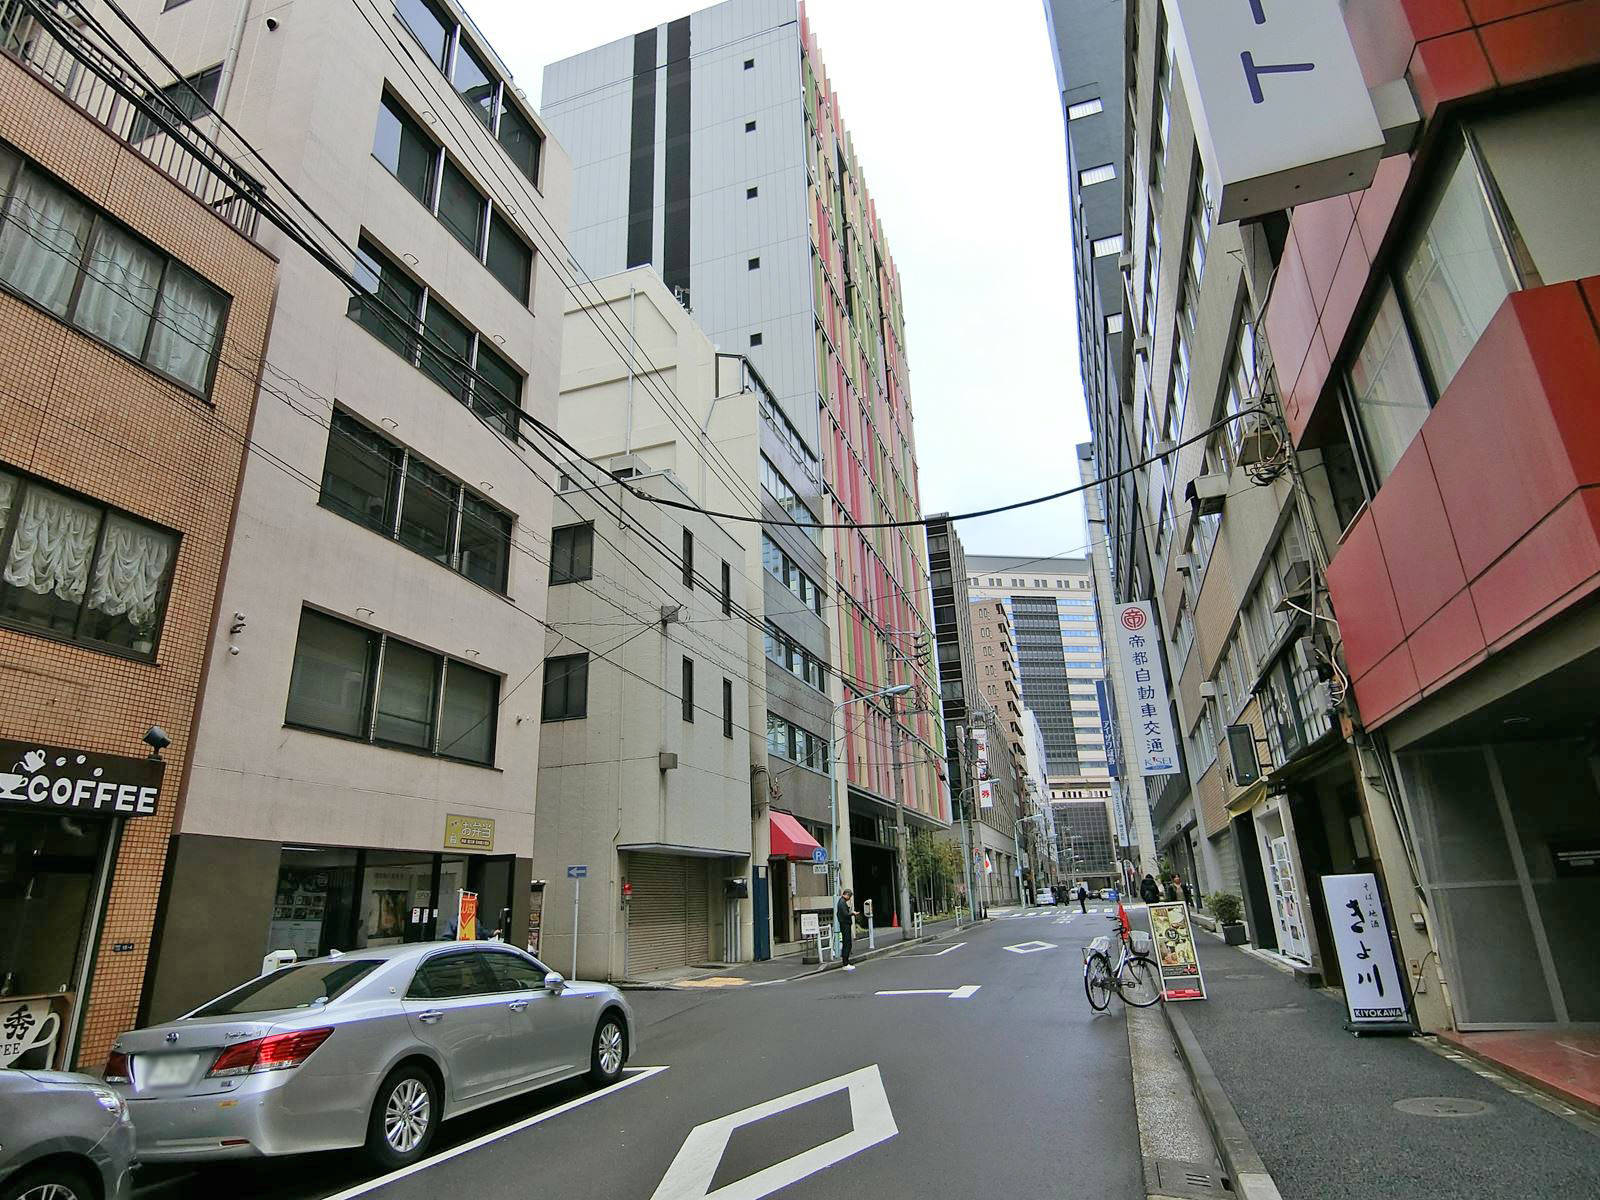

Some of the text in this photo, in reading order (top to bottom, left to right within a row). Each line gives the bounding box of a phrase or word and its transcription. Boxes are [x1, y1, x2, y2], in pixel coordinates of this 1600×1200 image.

[1129, 634, 1164, 754] 帝都自動車交通
[28, 774, 158, 814] COFFEE
[461, 821, 492, 838] お弁当
[3, 1003, 36, 1041] 秀
[1355, 1008, 1403, 1018] KIYOKAWA
[0, 1042, 21, 1056] EE
